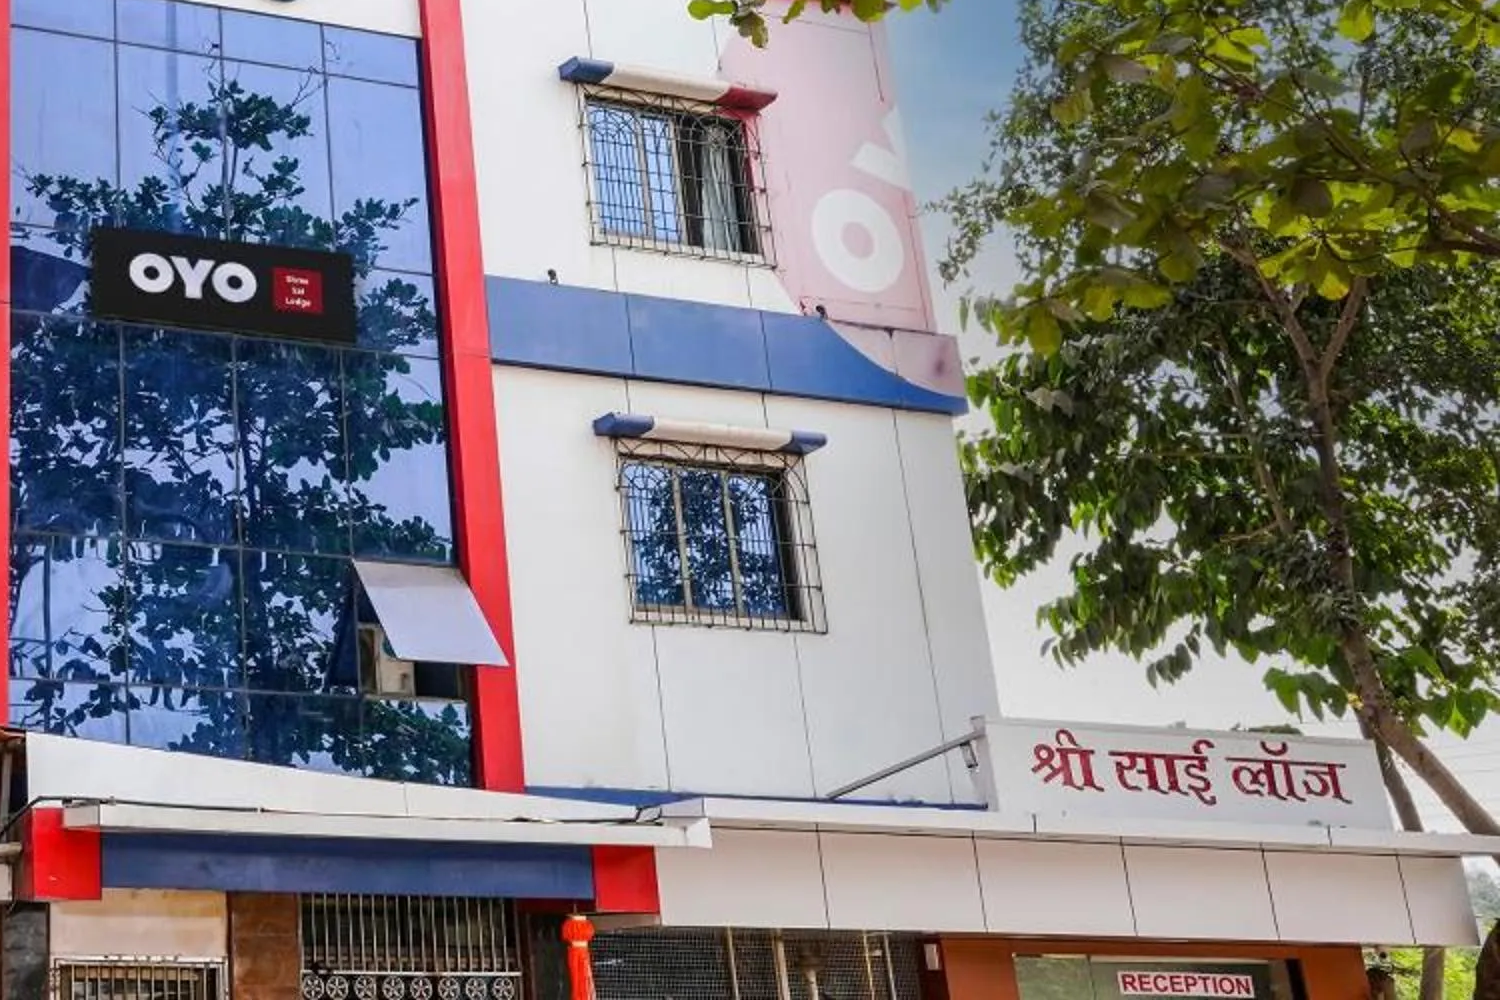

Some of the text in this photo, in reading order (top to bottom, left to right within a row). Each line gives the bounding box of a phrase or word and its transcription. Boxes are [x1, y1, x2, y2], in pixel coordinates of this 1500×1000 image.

[129, 253, 257, 303] OYO
[1031, 729, 1352, 805] श्री साई लॉज
[1121, 973, 1250, 995] RECEPTION
